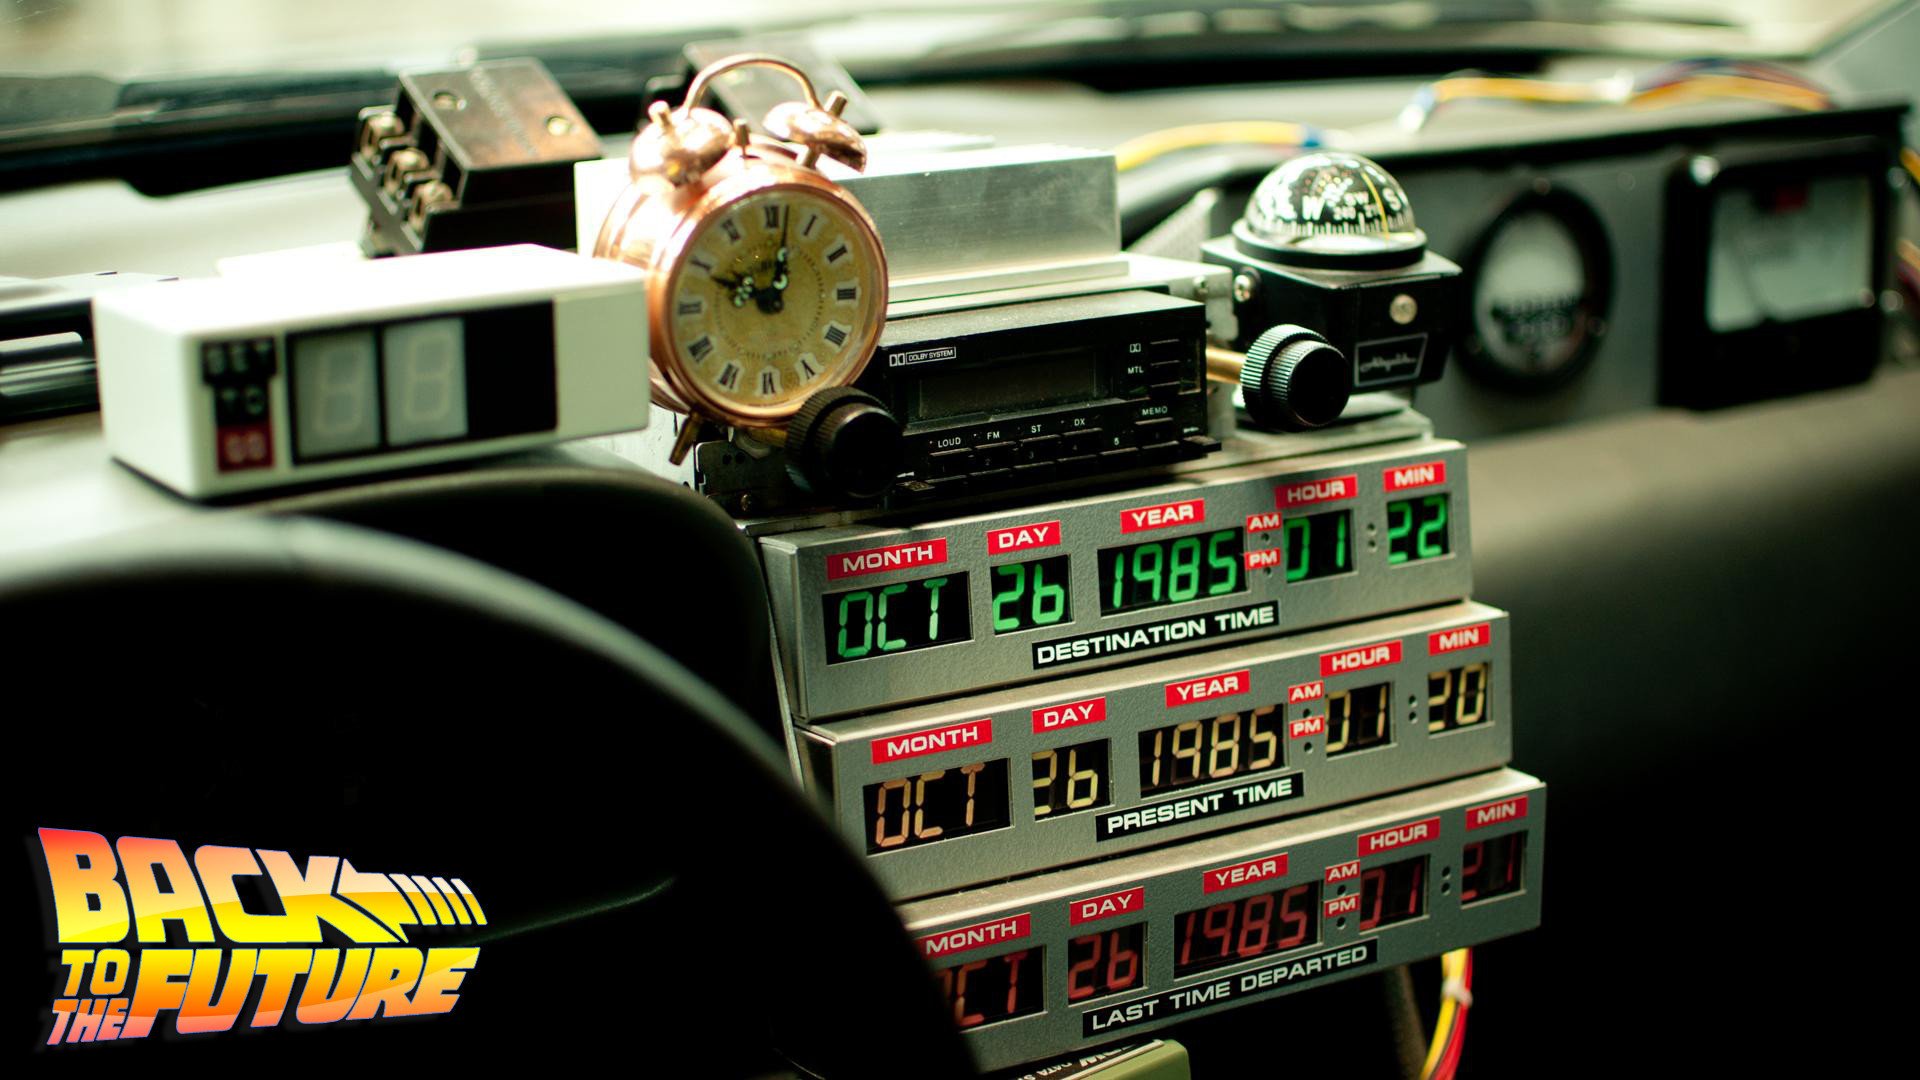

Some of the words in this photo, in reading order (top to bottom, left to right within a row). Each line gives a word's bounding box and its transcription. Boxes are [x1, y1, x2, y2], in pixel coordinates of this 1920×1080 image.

[908, 352, 928, 362] DOLBY
[929, 349, 954, 358] SYSTEM
[1127, 365, 1144, 375] MTL
[1073, 418, 1086, 426] DX
[1141, 406, 1168, 415] MEMO
[986, 431, 1000, 440] FM
[1030, 424, 1042, 434] ST
[937, 436, 962, 448] LOUD
[1394, 465, 1434, 487] MIN
[1287, 480, 1346, 503] HOUR
[1132, 504, 1194, 527] YEAR
[1250, 514, 1280, 530] AM
[998, 526, 1049, 549] DAY
[1388, 492, 1447, 565] 22
[843, 545, 934, 572] MONTH
[1249, 551, 1278, 567] PM
[1284, 515, 1345, 580] 01
[1113, 530, 1237, 608] 1985
[992, 564, 1065, 632] 26
[838, 578, 948, 658] OCT
[1037, 617, 1206, 665] DESTINATION
[1214, 605, 1275, 632] TIME
[1439, 629, 1479, 650] MIN
[1332, 646, 1390, 672] HOUR
[1176, 676, 1239, 702] YEAR
[1291, 684, 1322, 701] AM
[1043, 704, 1095, 728] DAY
[1293, 719, 1322, 735] PM
[887, 726, 979, 757] MONTH
[1152, 706, 1277, 786] 1985
[876, 763, 986, 847] OCT
[1107, 794, 1224, 834] PRESENT
[1233, 778, 1293, 805] TIME
[1476, 802, 1517, 824] MIN
[1369, 824, 1429, 850] HOUR
[1215, 861, 1277, 887] YEAR
[1327, 863, 1358, 881] AM
[1082, 894, 1133, 918] DAY
[1328, 897, 1357, 913] PM
[1180, 884, 1310, 966] 1985
[925, 921, 1017, 954] MONTH
[1068, 931, 1138, 999] 26
[1092, 999, 1159, 1030] LAST
[1169, 981, 1231, 1009] TIME
[1240, 945, 1368, 992] DEPARTED
